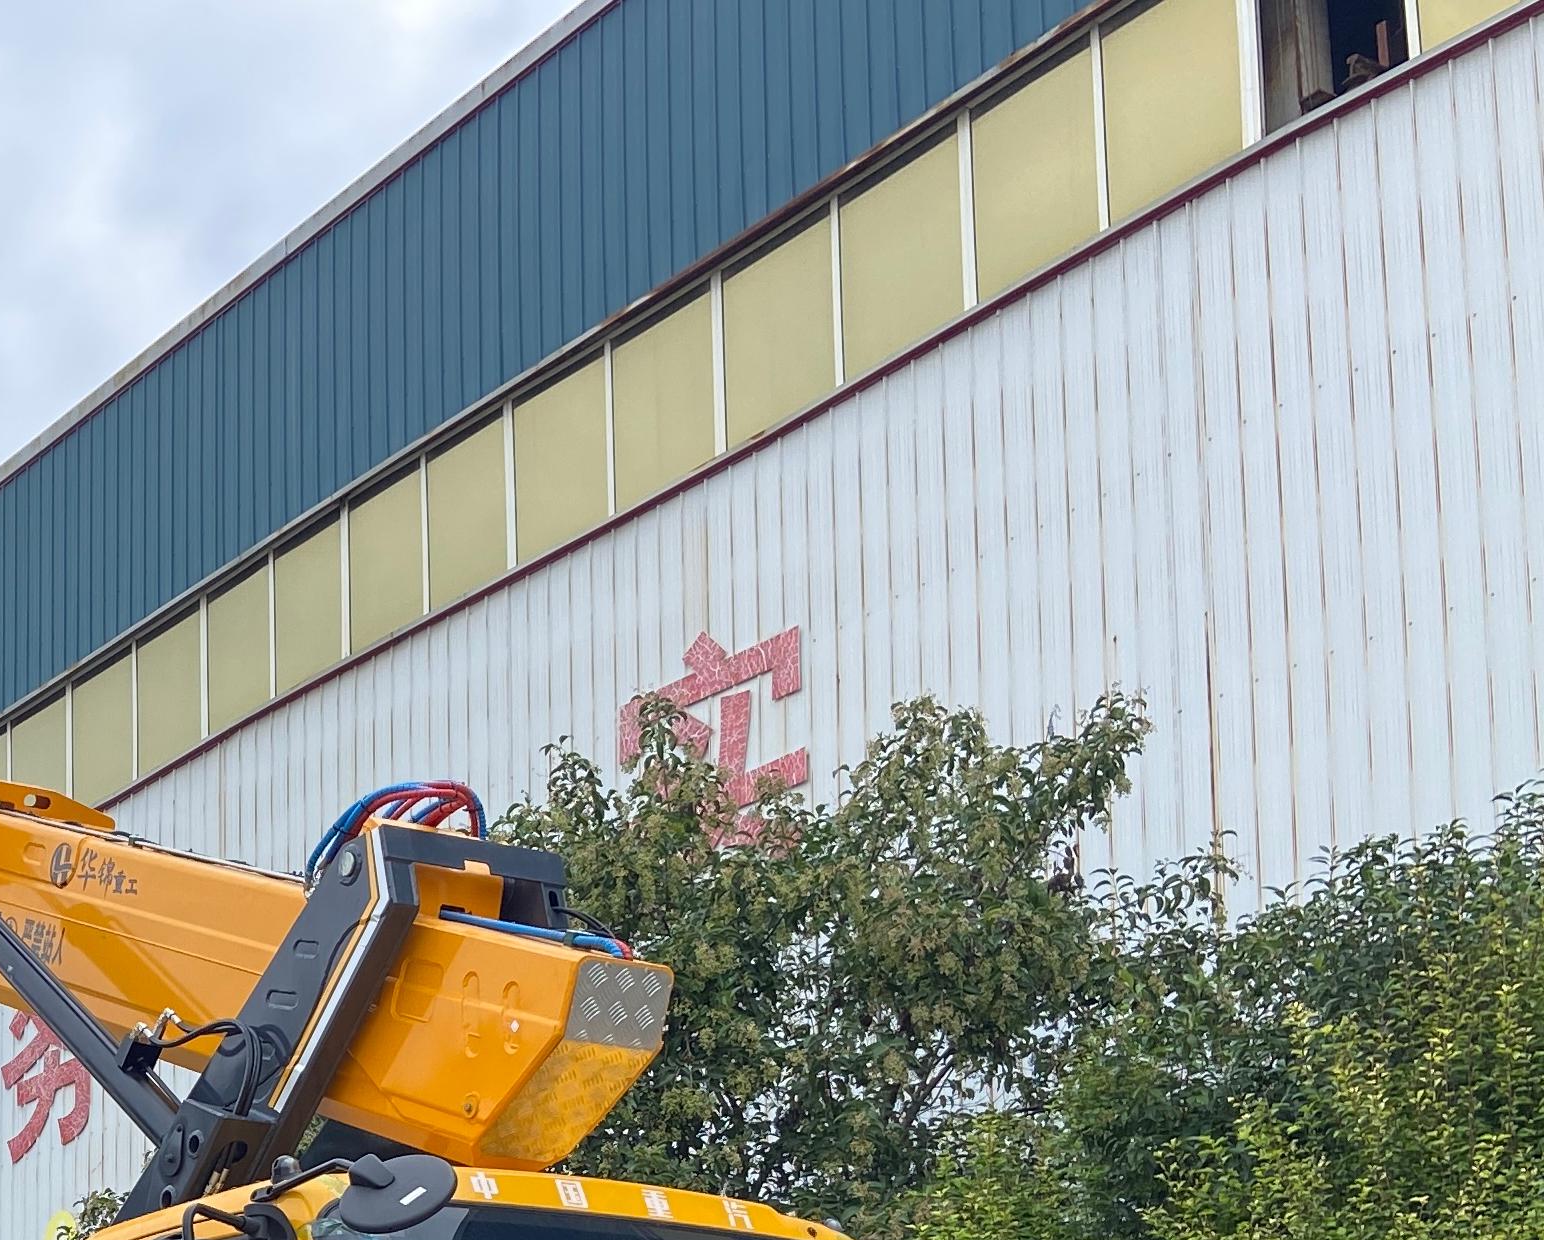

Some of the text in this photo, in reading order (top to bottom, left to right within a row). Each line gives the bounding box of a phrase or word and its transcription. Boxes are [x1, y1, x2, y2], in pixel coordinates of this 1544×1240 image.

[77, 848, 138, 900] 华锦重工
[470, 1172, 754, 1230] 中国重汽
